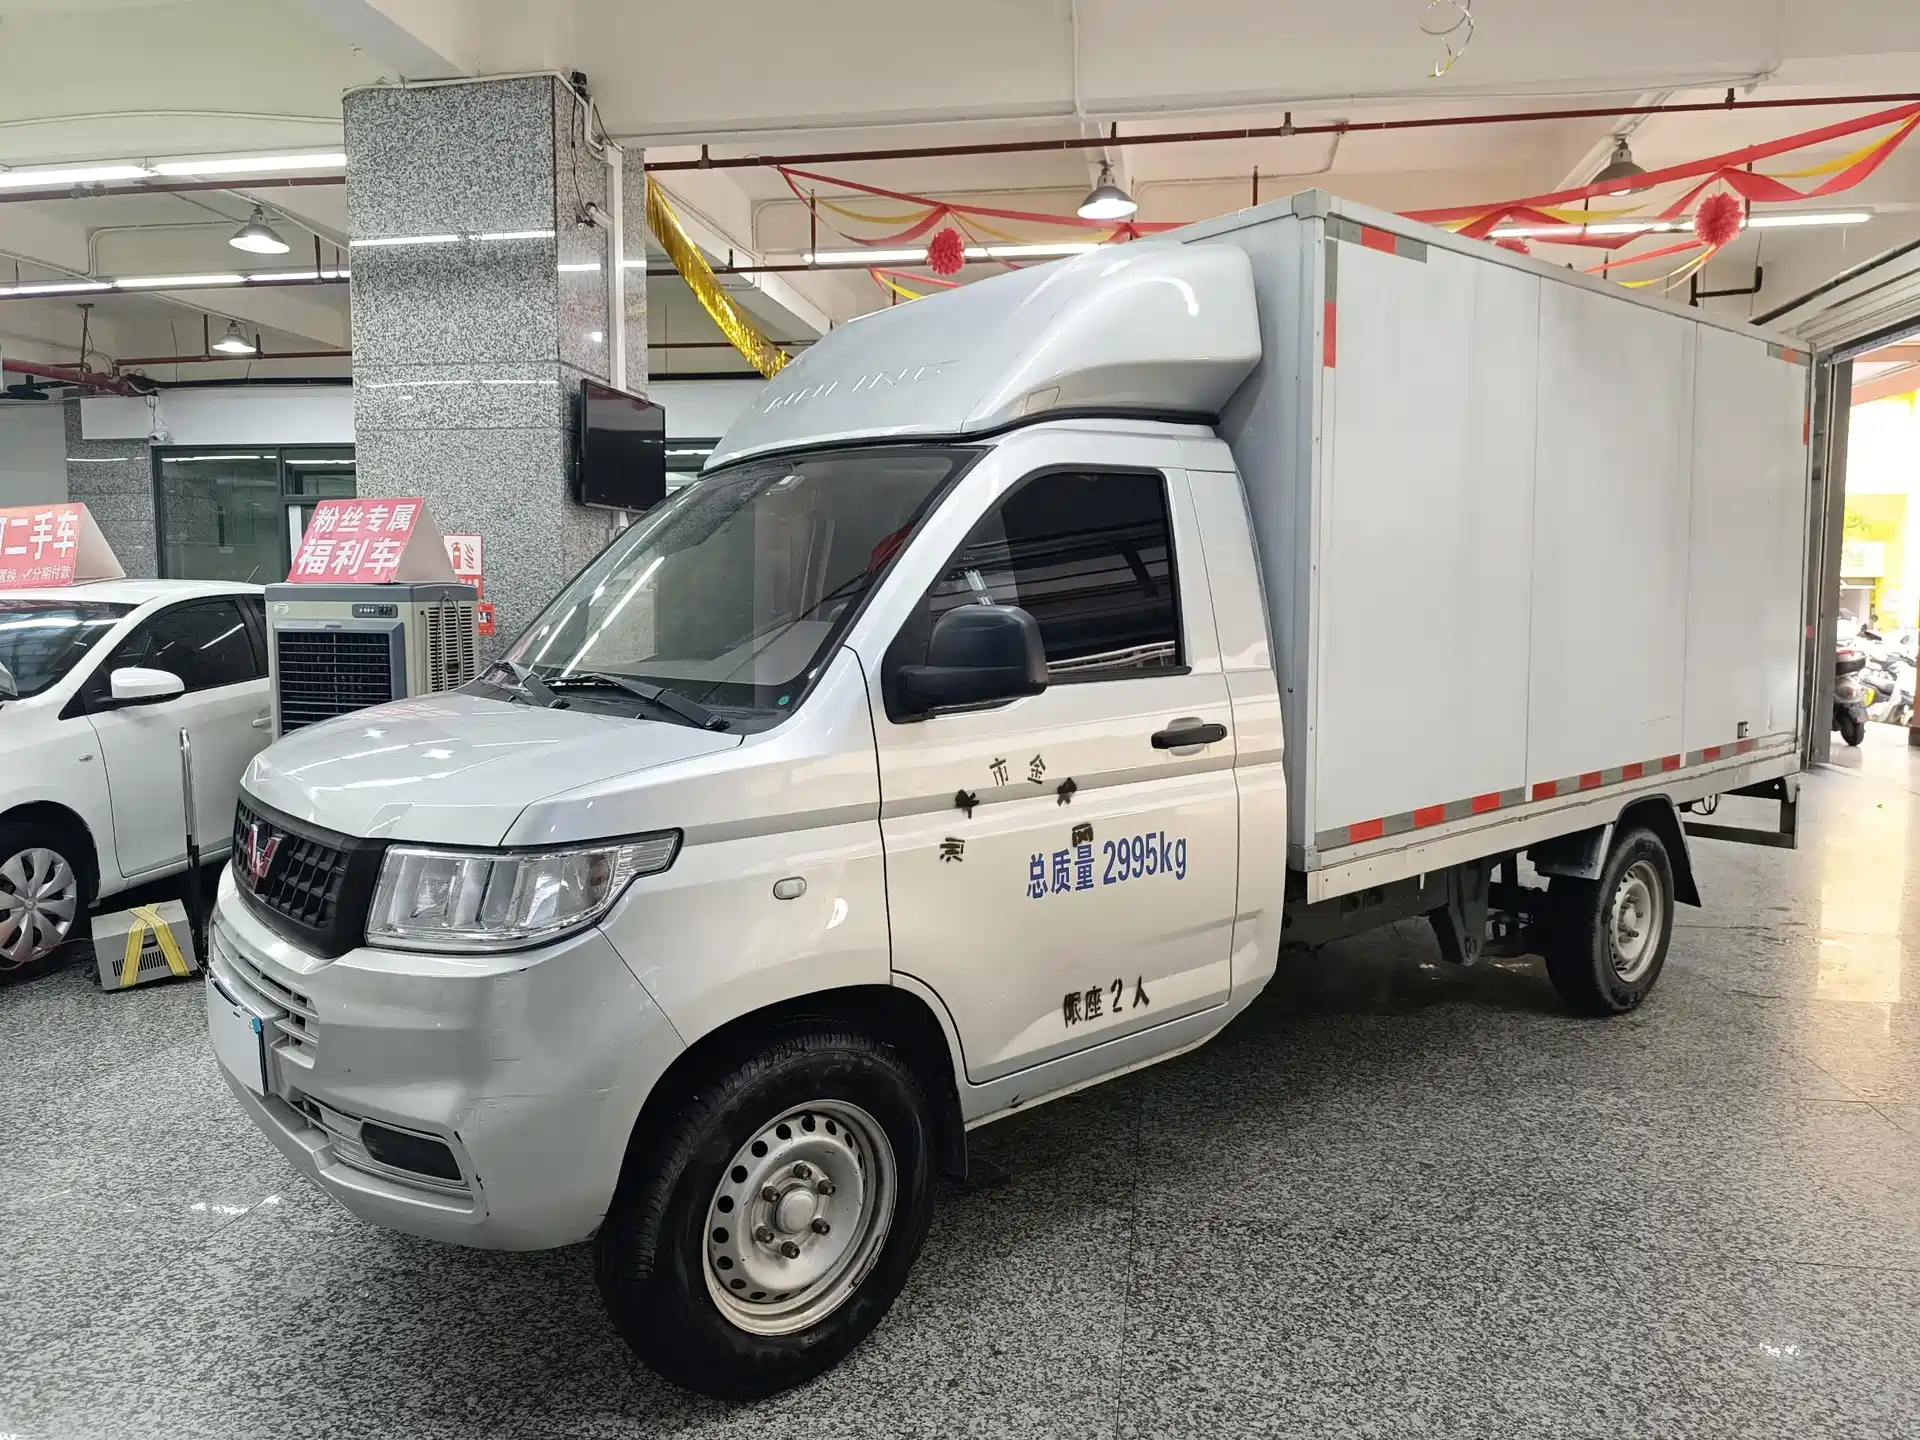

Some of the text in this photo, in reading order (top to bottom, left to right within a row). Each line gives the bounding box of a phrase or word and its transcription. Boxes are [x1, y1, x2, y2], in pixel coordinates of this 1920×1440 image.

[312, 504, 417, 533] 粉丝专属
[32, 564, 72, 581] 分期付款
[296, 536, 401, 576] 福利车
[1026, 843, 1095, 899] 总质量
[1103, 830, 1188, 885] 2995kg
